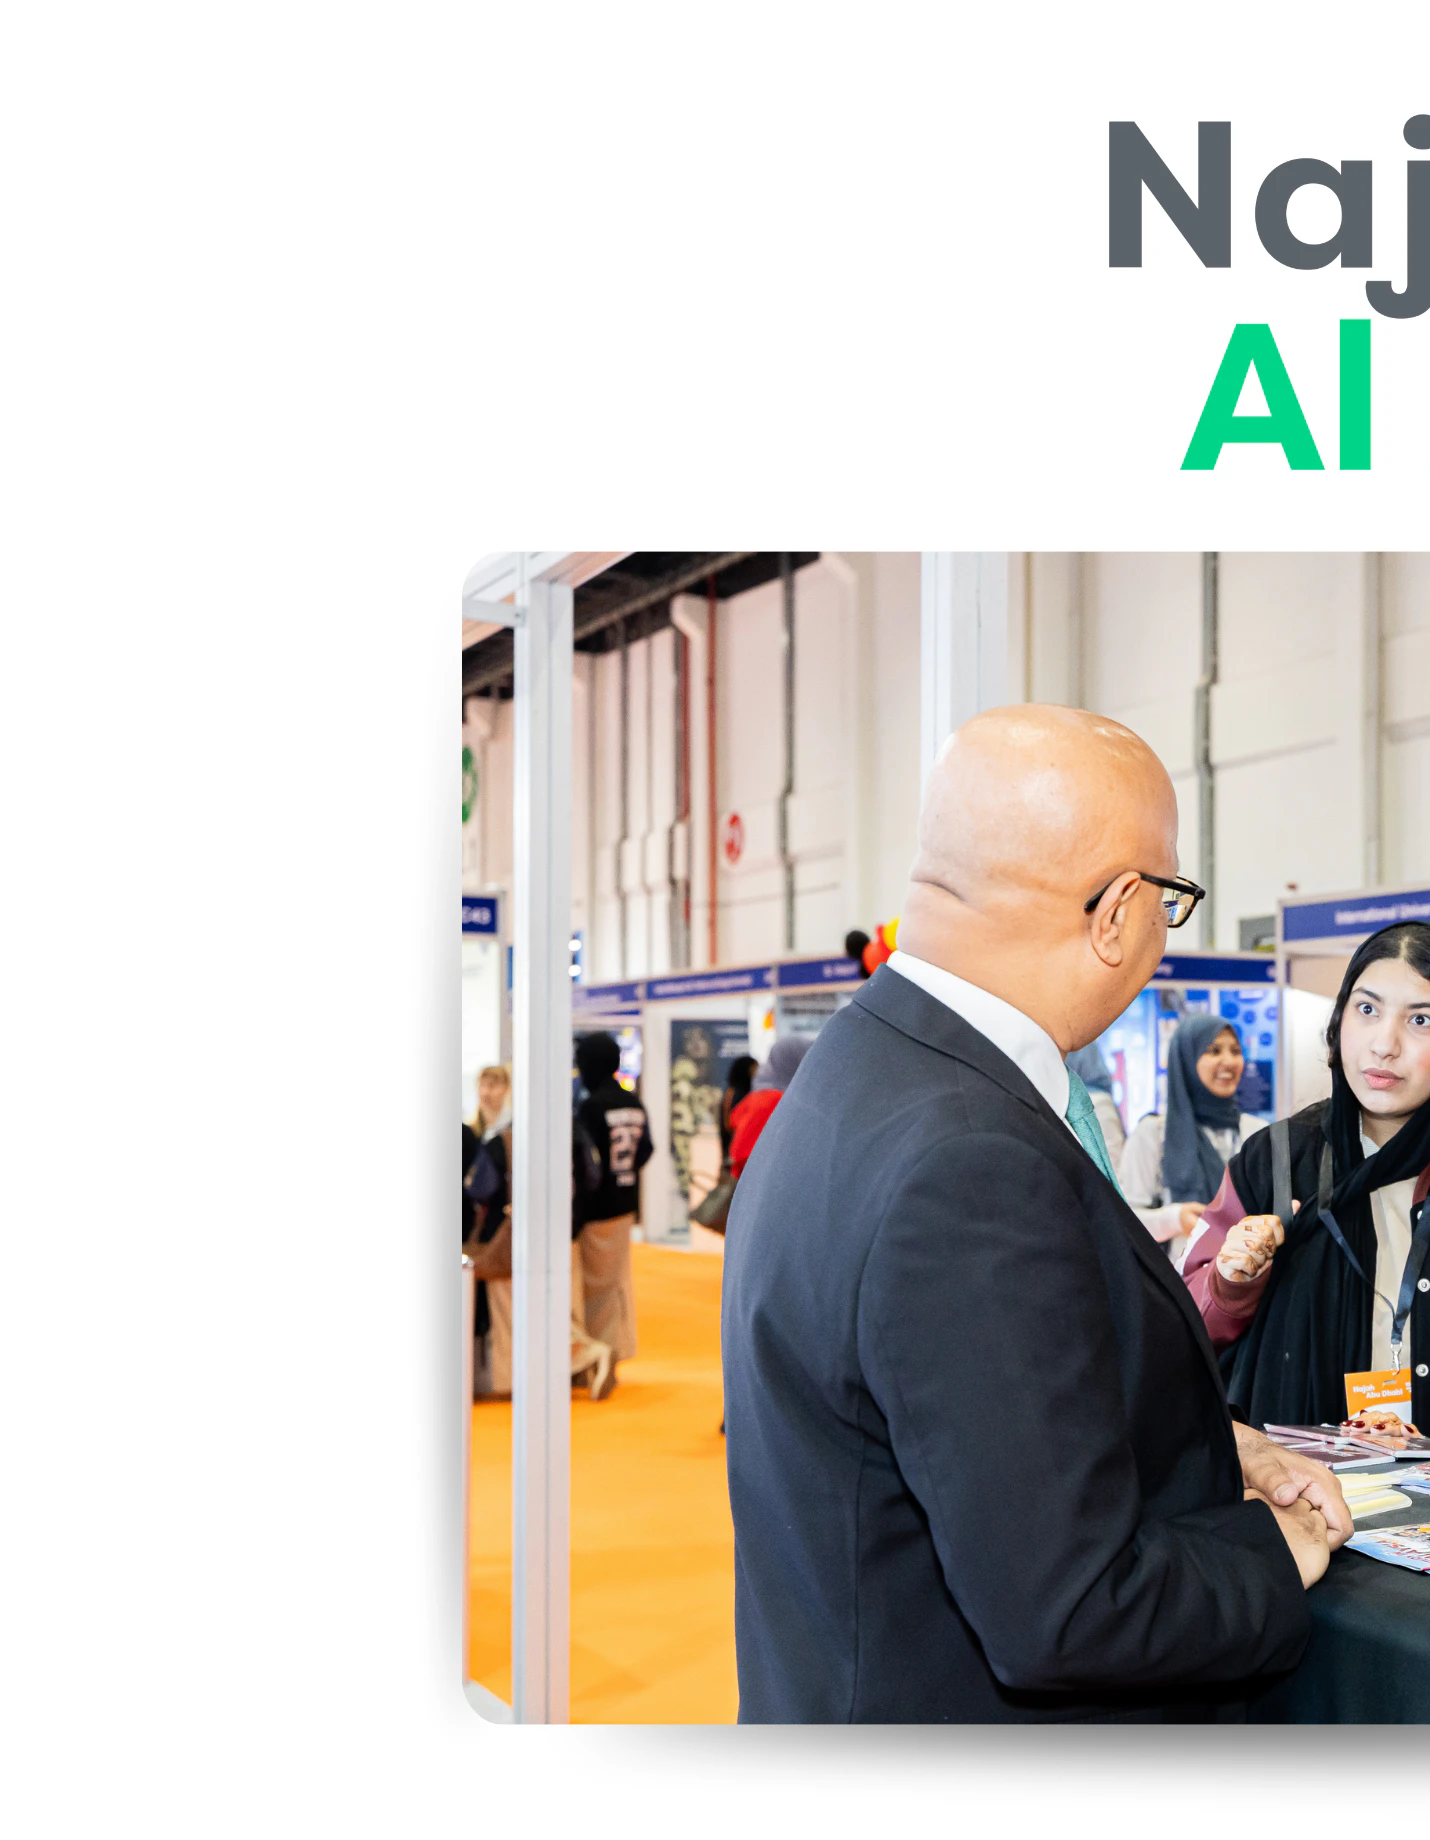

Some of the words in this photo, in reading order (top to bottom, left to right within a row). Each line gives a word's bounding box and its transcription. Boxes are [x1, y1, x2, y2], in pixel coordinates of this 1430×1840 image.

[1334, 906, 1397, 925] International
[1353, 1384, 1375, 1394] Najah
[1382, 1388, 1403, 1397] Dhabi
